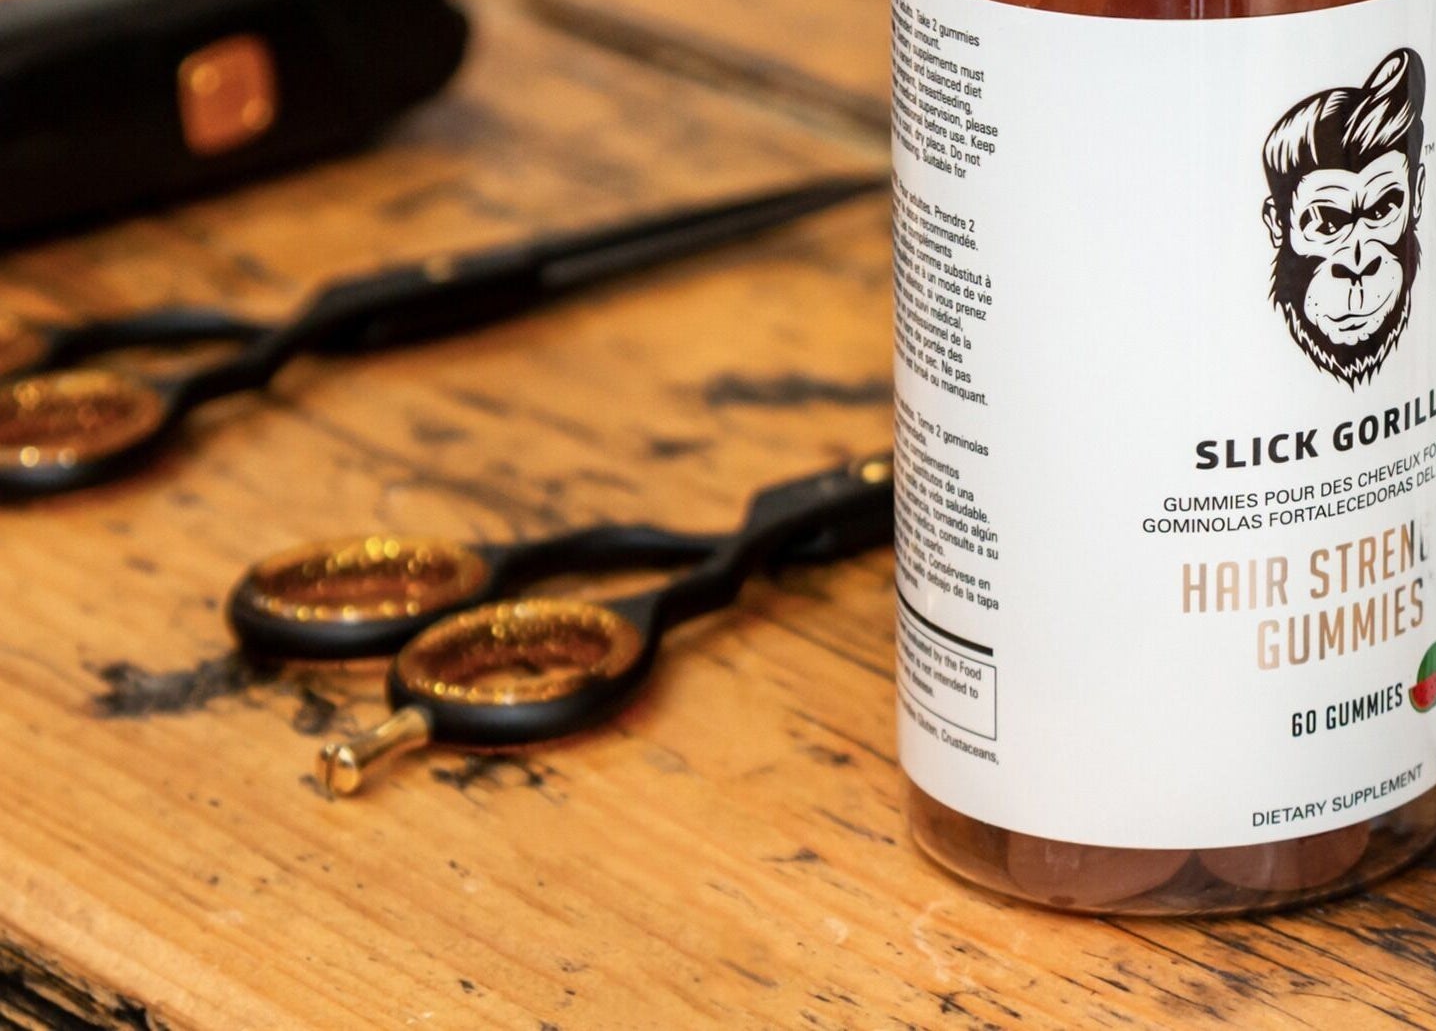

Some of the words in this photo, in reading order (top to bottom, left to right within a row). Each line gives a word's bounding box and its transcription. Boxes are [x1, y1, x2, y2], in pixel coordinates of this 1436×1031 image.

[932, 18, 937, 31] 2
[939, 23, 980, 47] gummies
[913, 44, 957, 74] supplements
[960, 65, 984, 82] must
[918, 81, 973, 115] breastfeeding,
[926, 66, 961, 92] balanced
[963, 82, 982, 99] diet
[918, 97, 962, 127] supervision,
[964, 118, 998, 137] please
[924, 114, 948, 137] before
[949, 129, 967, 146] use.
[970, 133, 996, 155] Keep
[922, 147, 953, 174] Suitable
[954, 162, 967, 179] for
[925, 135, 947, 155] place.
[950, 143, 962, 161] Do
[964, 152, 981, 167] not
[919, 216, 979, 251] recommandée.
[934, 204, 966, 230] Prendre
[968, 218, 975, 233] 2
[916, 248, 942, 270] comme
[943, 262, 982, 286] substitut
[985, 273, 992, 289] à
[927, 271, 937, 284] un
[938, 276, 961, 296] mode
[963, 285, 975, 300] de
[977, 290, 993, 306] vie
[935, 291, 954, 310] vous
[955, 301, 987, 321] prenez
[930, 306, 963, 332] médical,
[923, 335, 946, 357] portée
[947, 347, 963, 364] des
[950, 331, 961, 346] de
[963, 334, 972, 350] la
[941, 358, 953, 377] Ne
[955, 368, 971, 384] pas
[930, 373, 940, 387] ou
[941, 379, 989, 406] manquant.
[917, 410, 935, 434] Tome
[936, 423, 941, 437] 2
[943, 430, 989, 456] gominolas
[1195, 429, 1319, 470] SLICK
[945, 479, 955, 495] de
[957, 486, 974, 502] una
[1163, 493, 1258, 512] GUMMIES
[1265, 485, 1315, 506] POUR
[1321, 477, 1353, 498] DES
[1357, 452, 1421, 488] CHEVEUX
[929, 489, 943, 505] vida
[945, 498, 990, 524] saludable.
[1142, 515, 1263, 534] GOMINOLAS
[1268, 476, 1413, 527] FORTALECEDORAS
[1416, 466, 1436, 488] DEL
[933, 507, 969, 534] tomando
[971, 523, 998, 543] algún
[939, 529, 974, 553] consulte
[977, 543, 983, 555] a
[986, 547, 999, 560] su
[929, 552, 976, 587] Consérvese
[979, 577, 991, 591] en
[1182, 556, 1289, 614] HAIR
[953, 583, 963, 599] de
[966, 588, 974, 602] la
[977, 592, 999, 611] tapa
[1257, 577, 1424, 672] GUMMIES
[933, 647, 942, 666] by
[944, 653, 958, 671] the
[960, 660, 982, 681] Food
[934, 669, 967, 696] intended
[970, 685, 979, 700] to
[1291, 709, 1316, 738] 60
[1326, 682, 1403, 730] GUMMIES
[941, 726, 1000, 767] Crustaceans,
[1252, 800, 1328, 828] DIETARY
[1332, 763, 1424, 813] SUPPLEMENT
